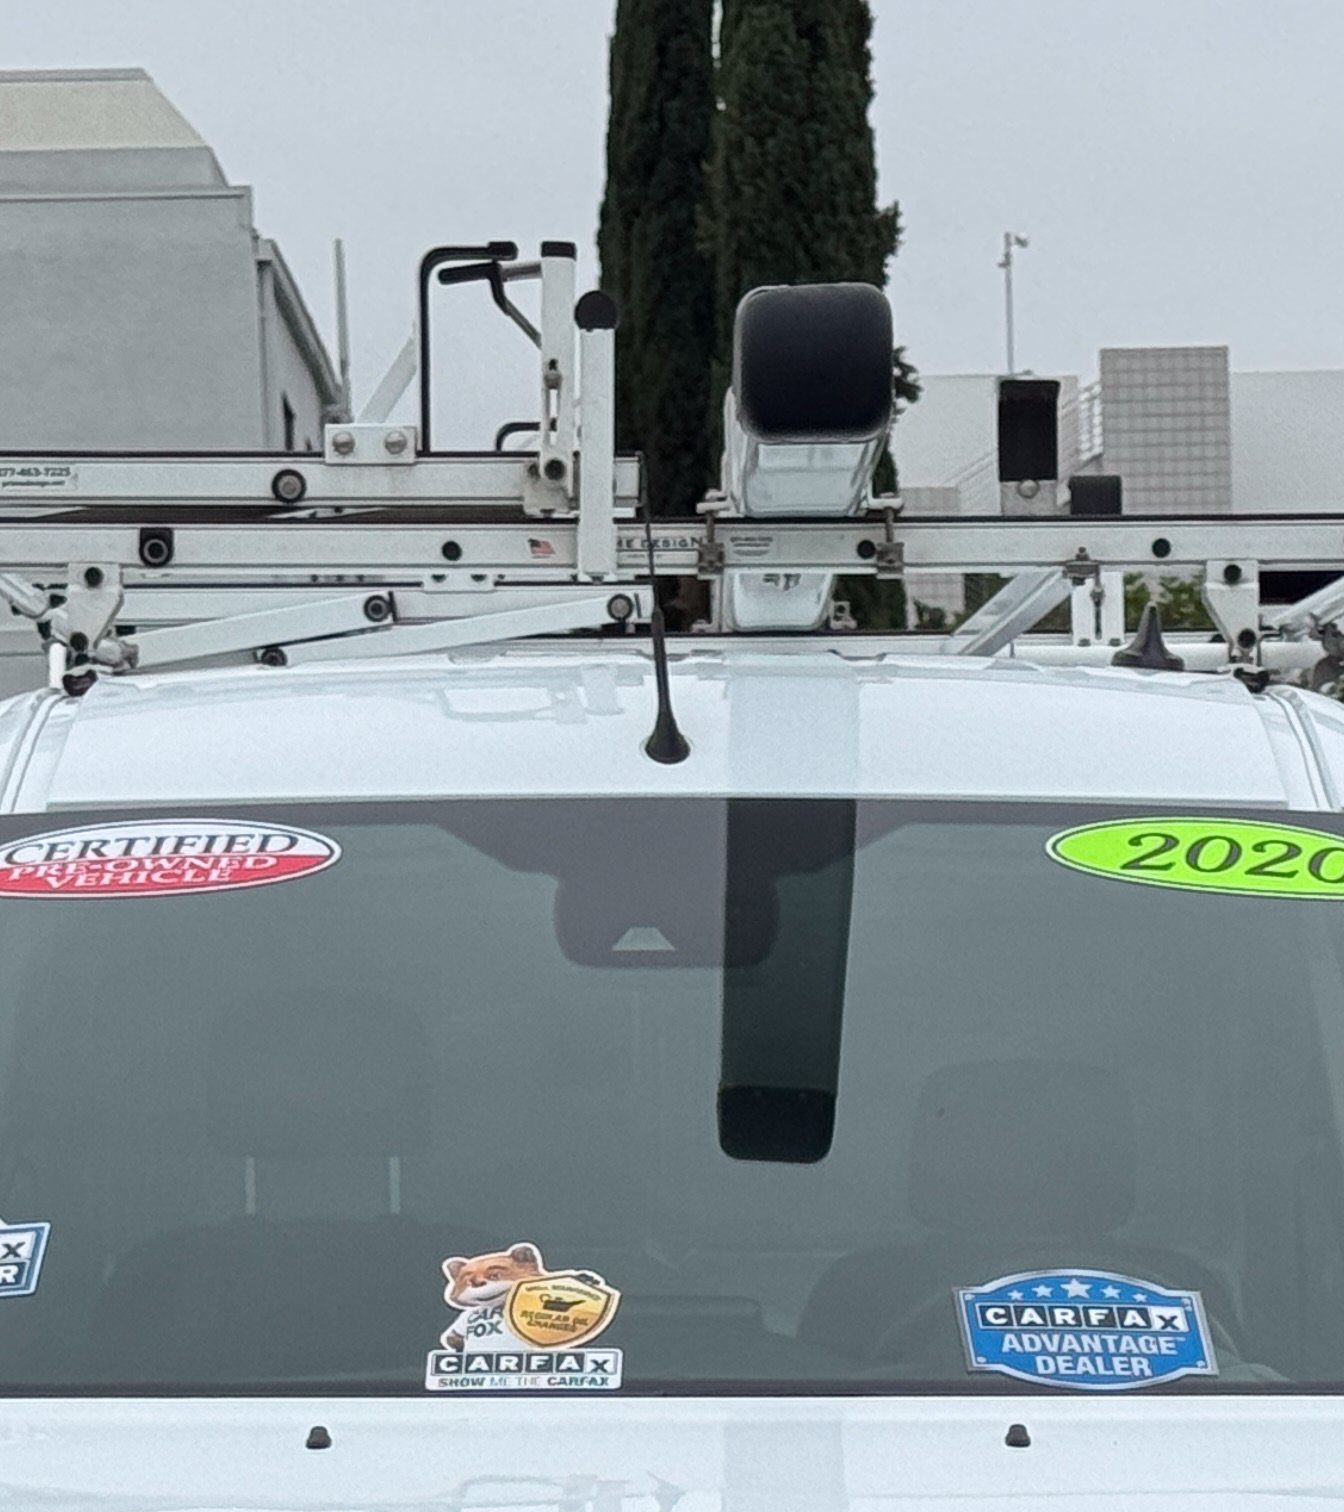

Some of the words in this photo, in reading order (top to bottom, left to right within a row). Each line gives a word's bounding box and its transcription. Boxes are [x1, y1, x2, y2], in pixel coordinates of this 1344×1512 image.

[5, 833, 299, 866] CERTIFIED
[8, 855, 278, 881] PRE-OWNED
[45, 867, 234, 889] VEHICLE
[467, 1307, 504, 1325] CAR
[985, 1307, 1181, 1331] CARFAX
[466, 1321, 504, 1341] FOX
[1001, 1333, 1179, 1356] ADVANTAGE
[439, 1355, 610, 1374] CARFAX
[1034, 1355, 1153, 1377] DEALER
[438, 1376, 486, 1388] SHOW
[547, 1376, 609, 1387] CARFAX
